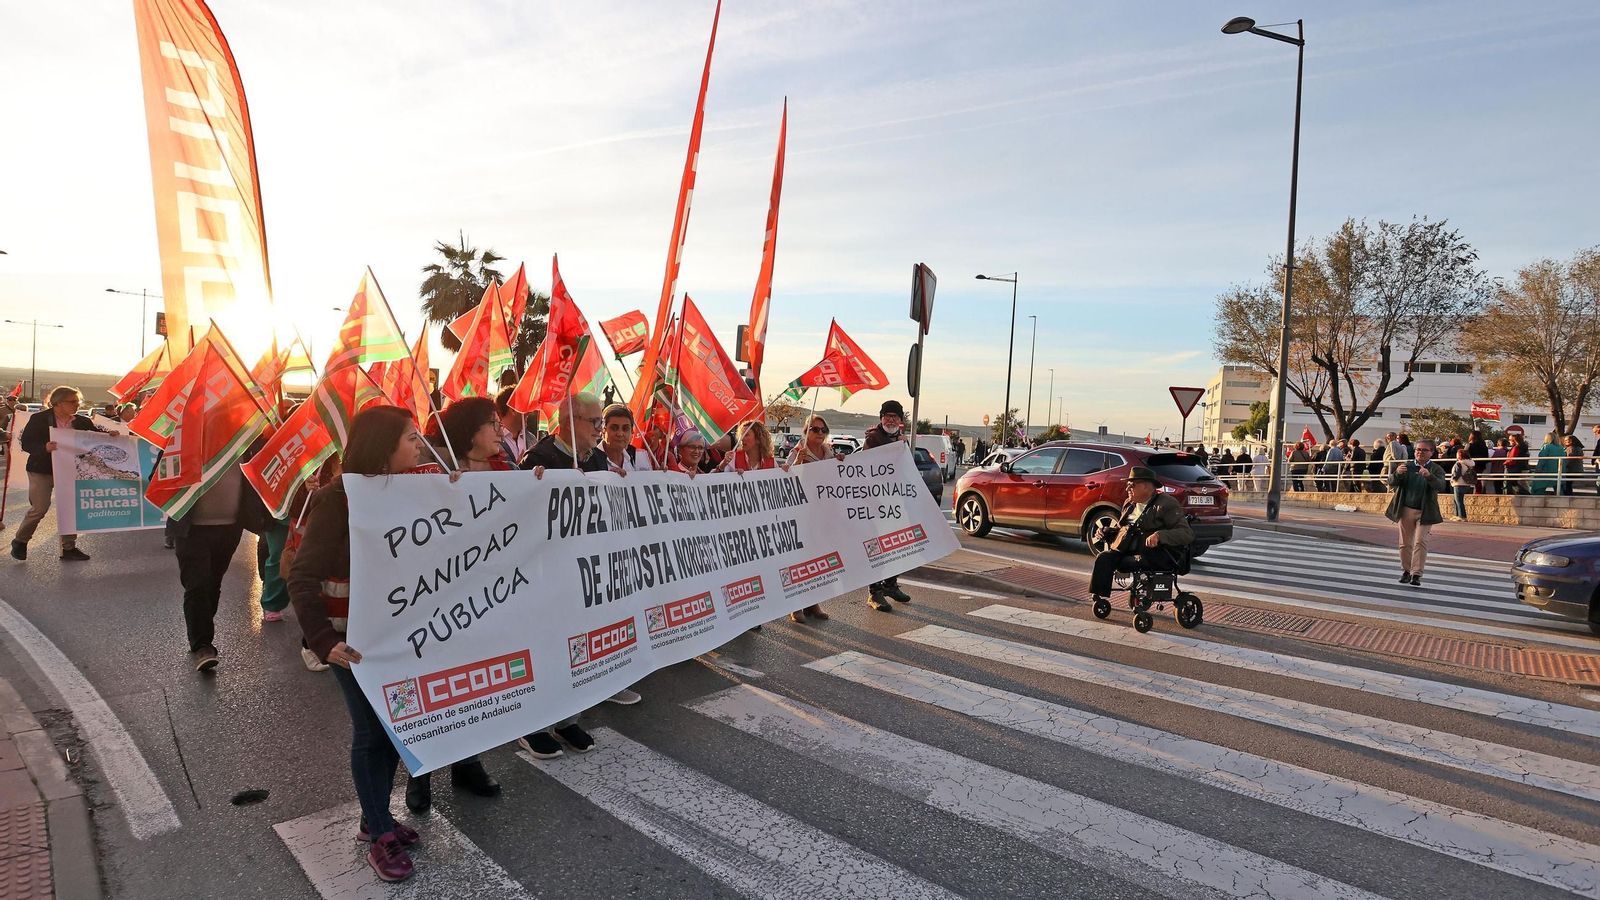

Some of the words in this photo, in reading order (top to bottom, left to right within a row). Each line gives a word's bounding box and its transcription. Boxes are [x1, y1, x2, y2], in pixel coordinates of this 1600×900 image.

[708, 380, 740, 416] Cádiz
[837, 464, 866, 478] POR
[870, 463, 895, 477] LOS
[79, 486, 138, 498] mareas
[816, 482, 917, 499] PROFESIONALES
[80, 498, 139, 510] blancas
[88, 509, 131, 519] gaditanas
[547, 486, 585, 540] POR
[587, 485, 608, 534] EL
[643, 484, 669, 525] DE
[706, 481, 761, 520] ATENCION
[757, 475, 809, 512] PRIMARIA
[847, 506, 875, 520] DEL
[878, 504, 902, 519] SAS
[384, 508, 463, 558] POR
[469, 482, 507, 519] LA
[882, 530, 915, 548] CCOO
[387, 523, 519, 617] SANIDAD
[577, 554, 603, 608] DE
[718, 528, 760, 569] SIERRA
[756, 524, 775, 558] DE
[771, 514, 804, 554] CÁDIZ
[791, 559, 828, 580] CCOO
[728, 582, 752, 600] CCOO
[407, 567, 530, 659] PÚBLICA
[669, 598, 706, 622] CCOO
[687, 620, 703, 631] sanidad
[591, 625, 629, 654] CCOO
[651, 633, 693, 650] sociosanitarios
[571, 661, 598, 678] federación
[598, 659, 604, 667] de
[604, 654, 620, 666] sanidad
[620, 651, 624, 659] y
[426, 662, 509, 704] CCOO
[572, 671, 608, 689] sociosanitarios
[393, 713, 443, 734] federación
[445, 709, 456, 719] de
[459, 698, 494, 715] sanidad
[495, 696, 500, 706] y
[502, 685, 536, 701] sectores
[400, 720, 466, 746] ociosanitarios
[468, 714, 480, 725] de
[481, 702, 522, 721] Andalucía
